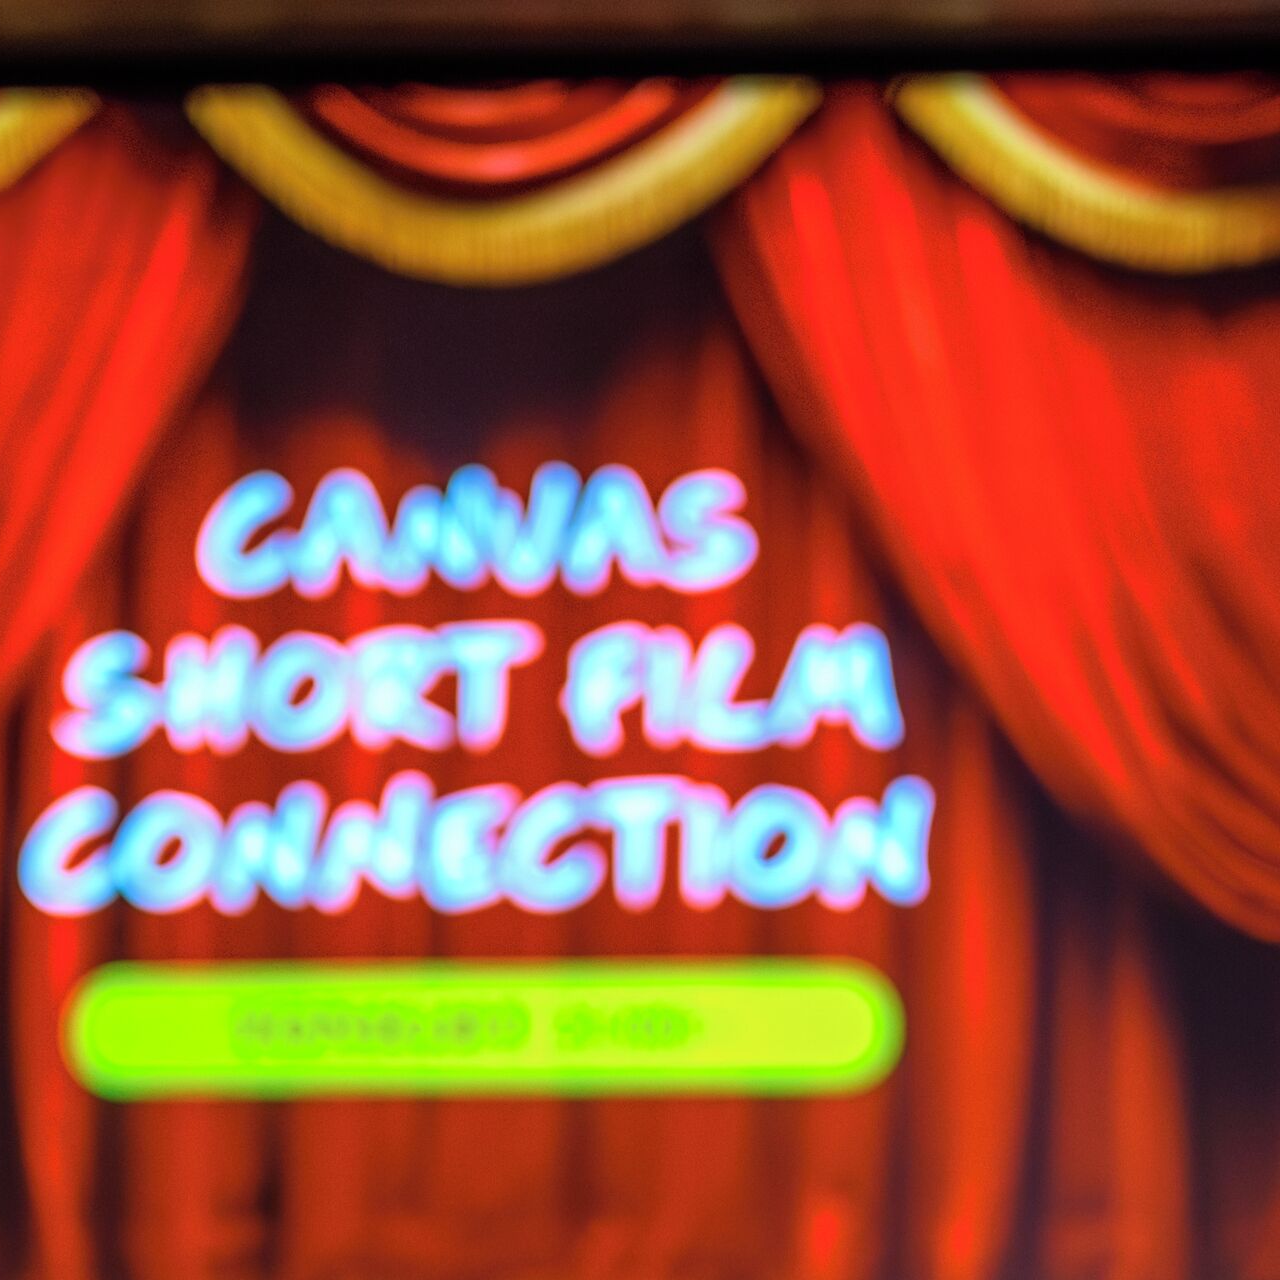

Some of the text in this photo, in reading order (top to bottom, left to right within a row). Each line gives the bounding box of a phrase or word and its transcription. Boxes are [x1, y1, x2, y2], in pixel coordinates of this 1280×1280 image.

[196, 461, 760, 598] CANVAS
[51, 620, 904, 758] SHORT FILM
[18, 771, 936, 916] CONNECTION
